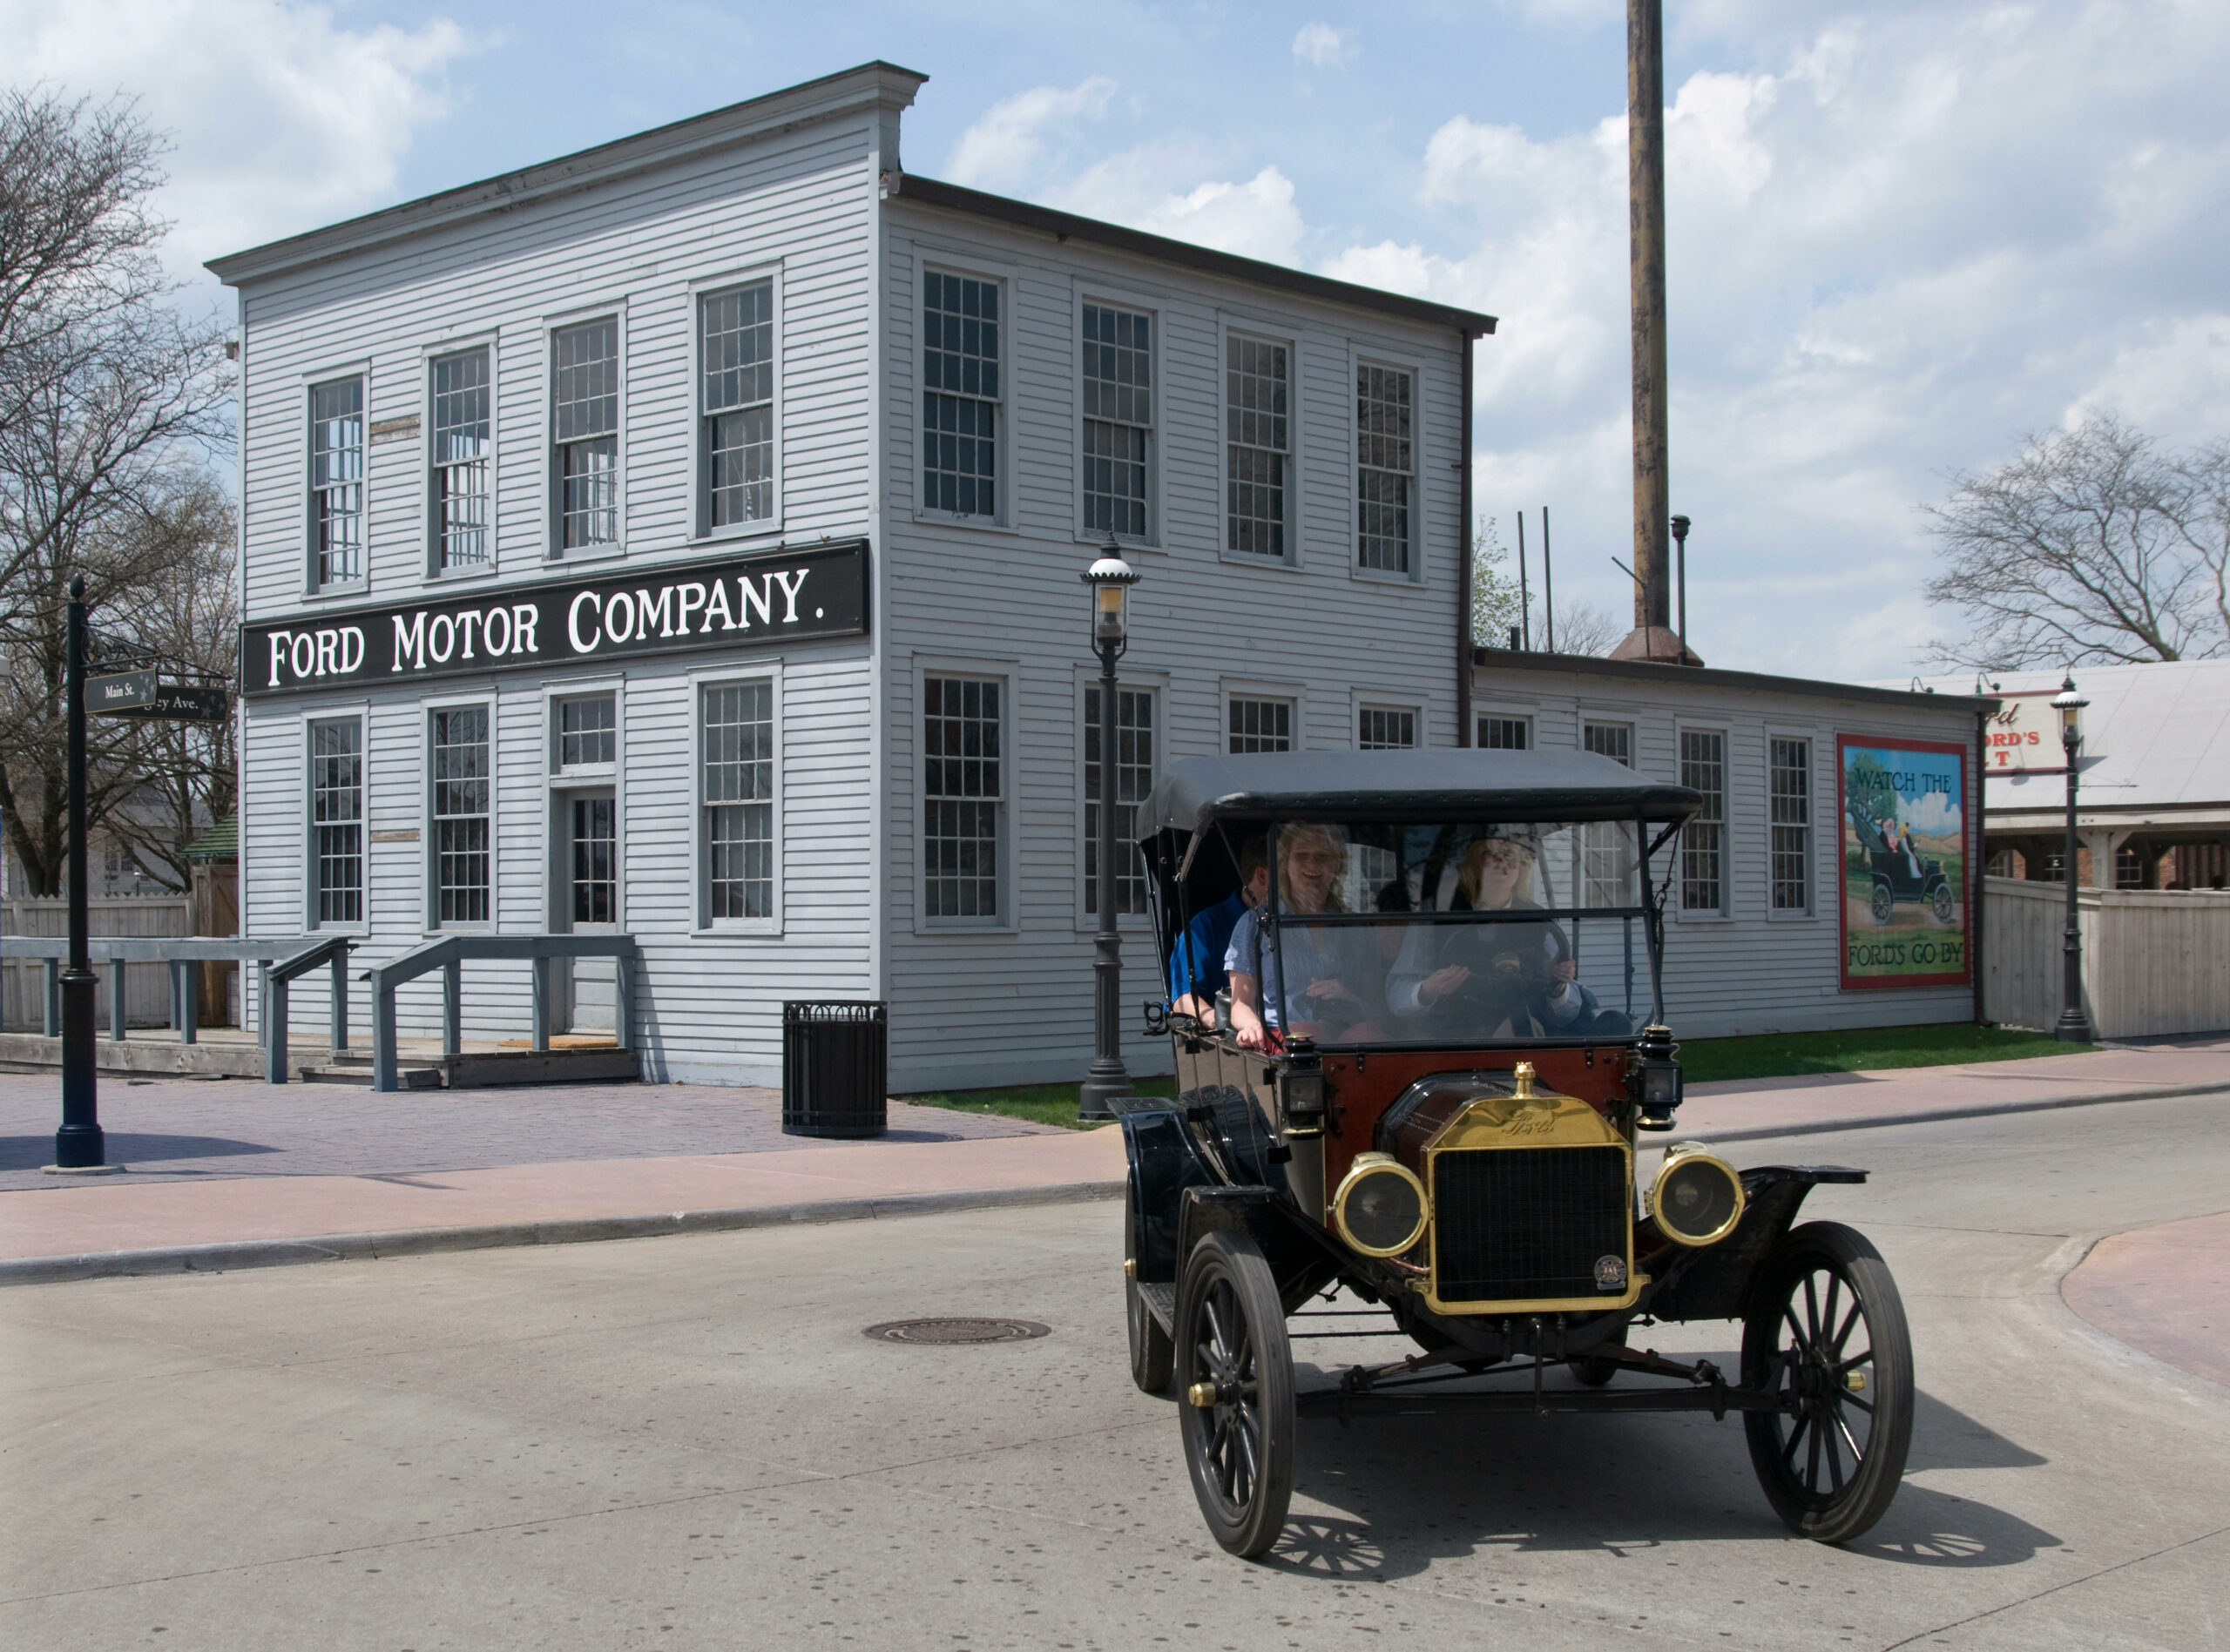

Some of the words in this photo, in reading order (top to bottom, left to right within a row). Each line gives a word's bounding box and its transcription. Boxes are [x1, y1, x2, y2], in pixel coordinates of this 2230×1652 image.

[267, 626, 366, 686] FORD
[391, 603, 539, 672] MOTOR
[567, 568, 824, 654] COMPANY.
[105, 684, 124, 699] Main
[125, 683, 135, 697] St.
[172, 696, 199, 710] Ave.
[1855, 767, 1916, 792] WATCH
[1922, 772, 1952, 794] THE
[1912, 942, 1936, 964] GO
[1940, 941, 1963, 963] BY
[1501, 1112, 1561, 1136] Ford
